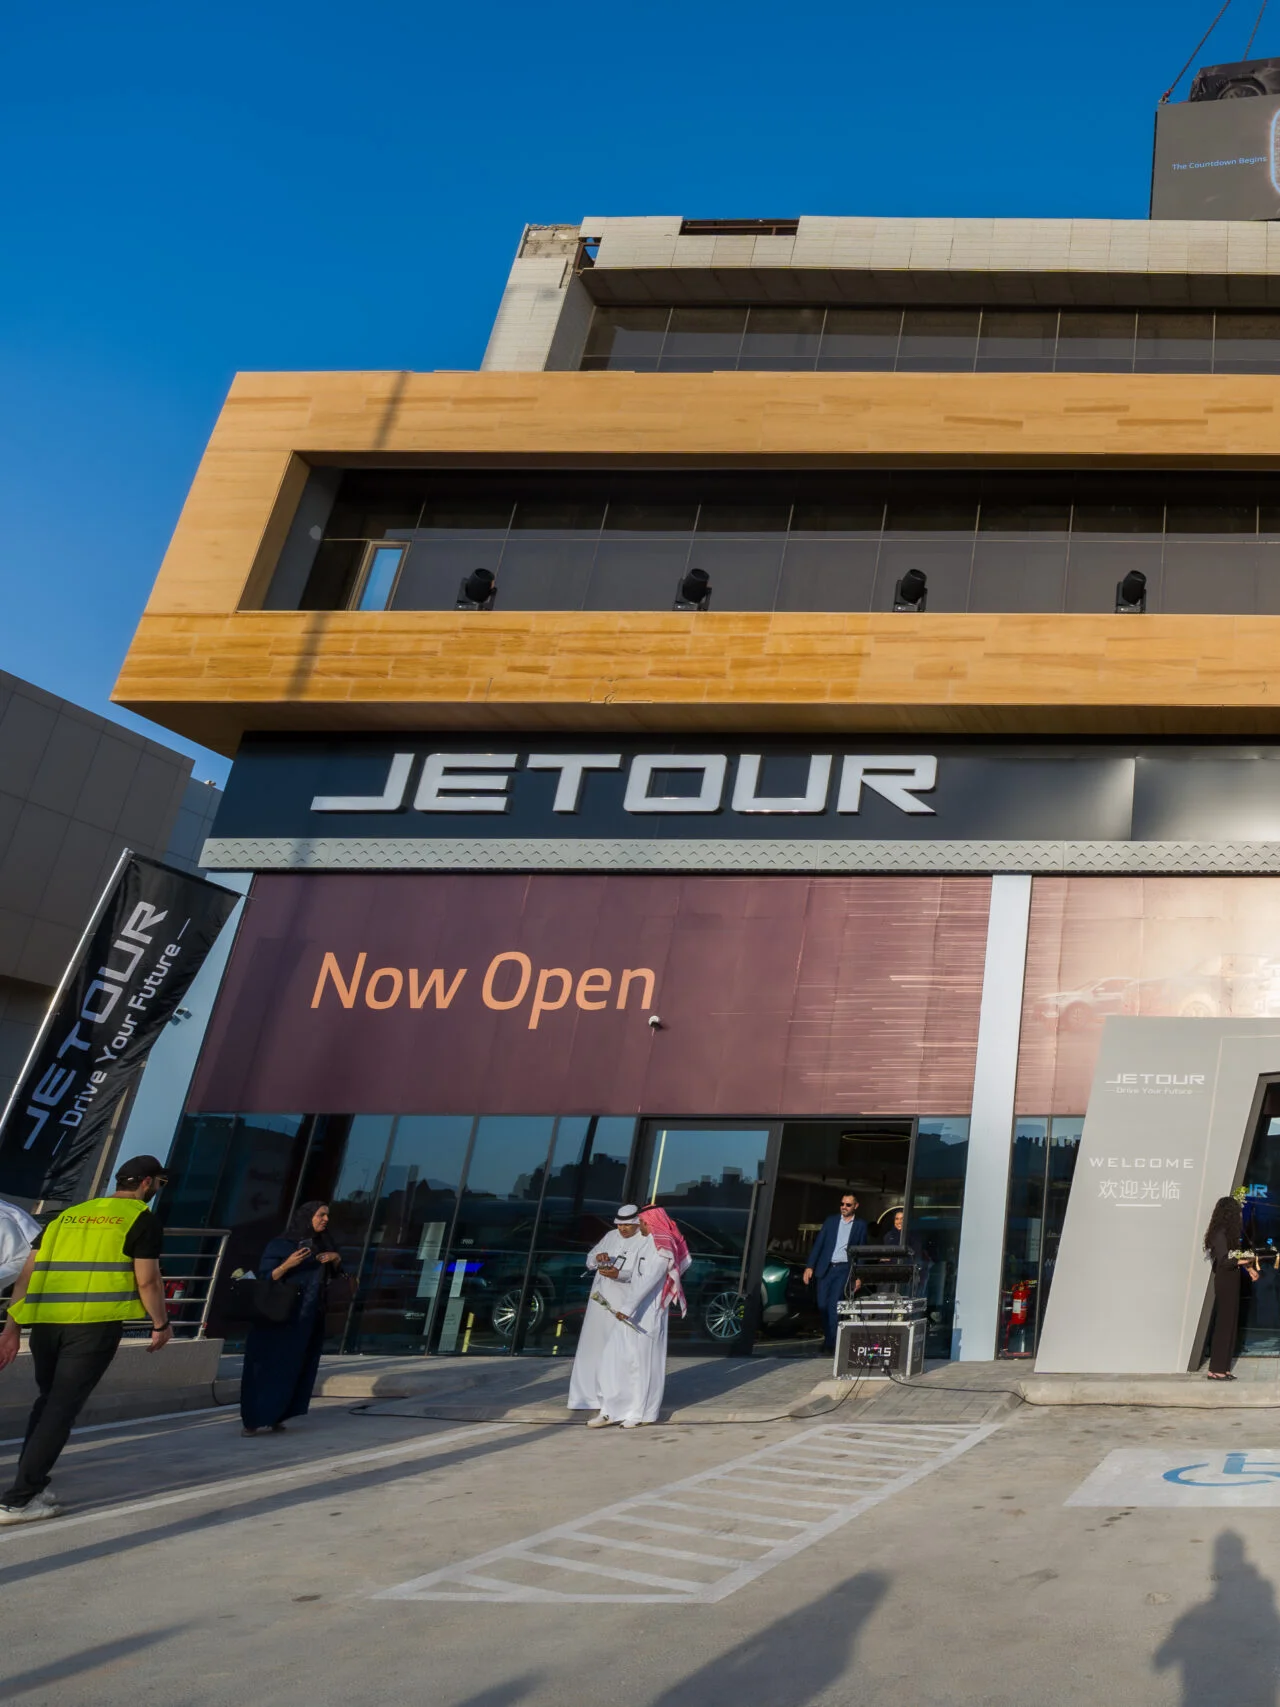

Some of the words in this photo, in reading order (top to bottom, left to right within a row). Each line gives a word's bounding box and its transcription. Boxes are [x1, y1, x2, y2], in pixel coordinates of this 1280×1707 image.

[1171, 163, 1187, 171] The
[1189, 159, 1237, 169] Countdown
[1238, 156, 1267, 165] Begins
[309, 752, 938, 815] JETOUR
[310, 951, 467, 1011] Now
[481, 950, 657, 1030] Open
[23, 900, 169, 1151] JETOUR
[59, 1070, 108, 1127] Drive
[96, 1013, 139, 1062] Your
[127, 943, 181, 1014] Future
[1104, 1073, 1205, 1085] JETOUR
[1089, 1157, 1194, 1169] WELCOME
[1097, 1179, 1182, 1201] 欢迎光临
